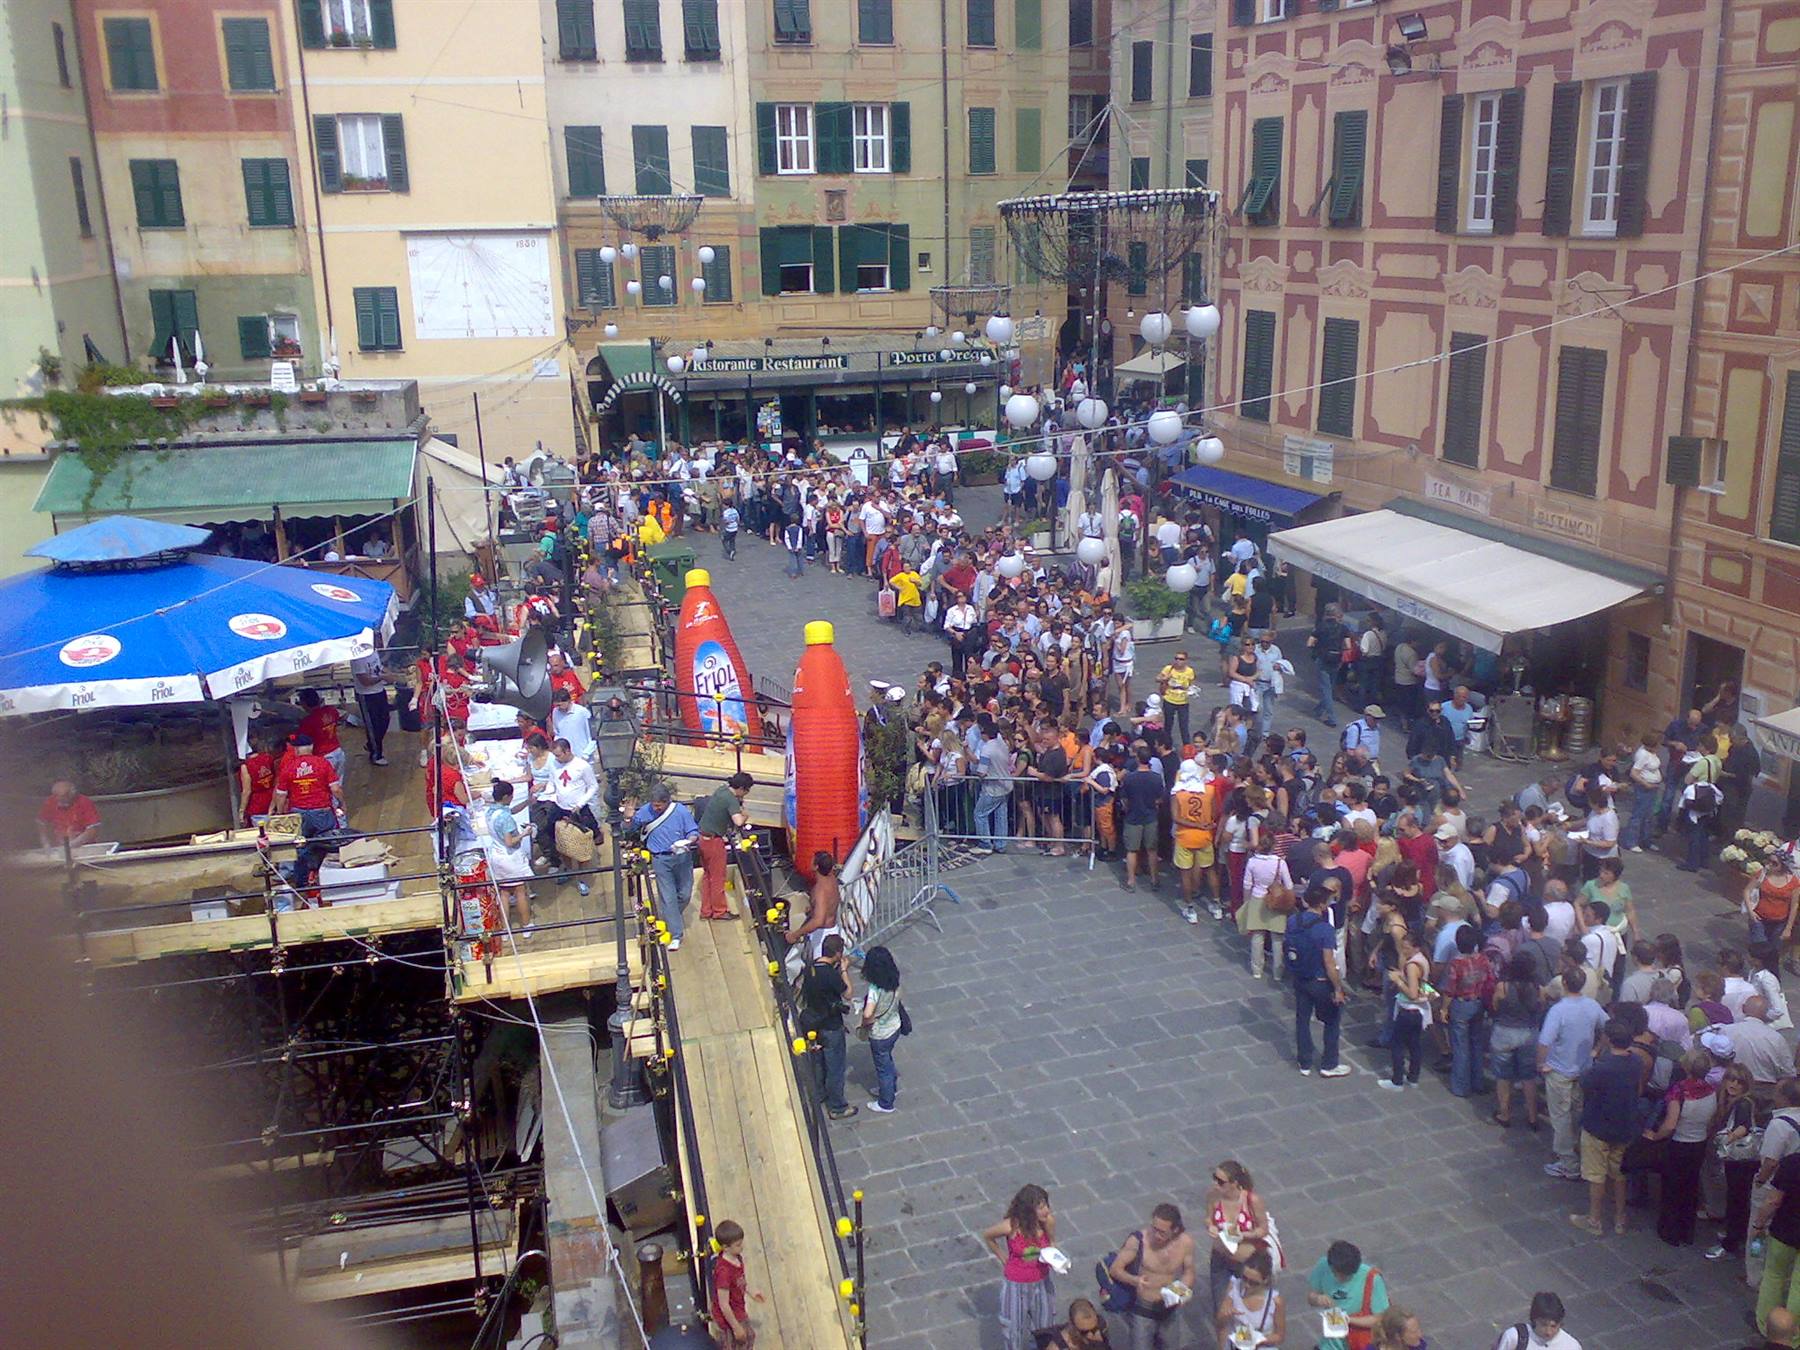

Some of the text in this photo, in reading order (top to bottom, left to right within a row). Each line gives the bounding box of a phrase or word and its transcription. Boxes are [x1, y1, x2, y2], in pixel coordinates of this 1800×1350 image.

[693, 355, 843, 371] Ristorante Restaurant
[891, 351, 936, 366] Porto
[1433, 482, 1450, 497] SEA
[1187, 796, 1203, 818] 2
